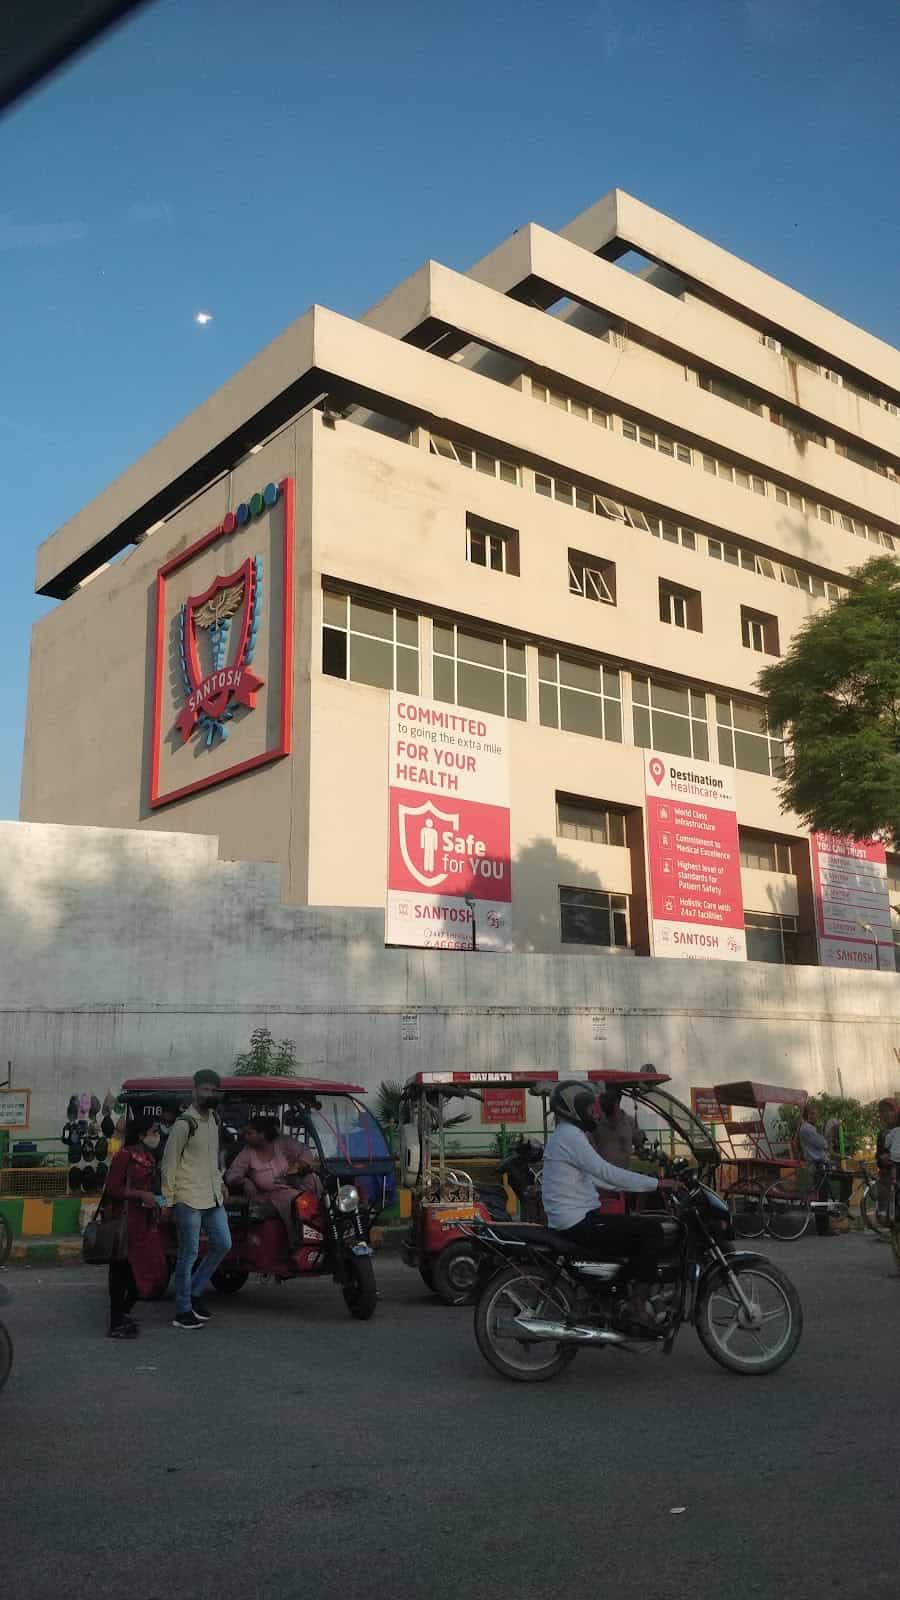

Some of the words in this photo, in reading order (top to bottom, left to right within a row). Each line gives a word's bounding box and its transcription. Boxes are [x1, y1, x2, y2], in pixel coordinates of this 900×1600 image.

[188, 670, 242, 712] SANTOSH
[396, 702, 487, 737] COMMITTED
[398, 722, 408, 734] to
[410, 727, 437, 743] going
[439, 731, 456, 745] the
[457, 737, 482, 751] extra
[483, 743, 503, 756] mile
[396, 740, 429, 763] FOR
[433, 747, 477, 773] YOUR
[396, 762, 459, 791] HEALTH
[669, 767, 724, 789] Destination
[670, 780, 719, 799] Healthcare
[673, 807, 692, 817] World
[674, 818, 716, 831] Infrastructure
[441, 830, 487, 857] Safe
[675, 833, 713, 847] Commitment
[676, 844, 700, 855] Medical
[700, 847, 731, 860] Excellence
[847, 846, 867, 859] TRUST
[441, 853, 465, 873] for
[468, 857, 504, 880] YOU
[677, 860, 702, 871] Highest
[702, 863, 717, 874] level
[678, 879, 702, 891] Patient
[702, 883, 722, 897] Safety
[414, 904, 475, 923] SANTOSH
[679, 897, 703, 908] Holistic
[703, 900, 717, 910] Care
[717, 903, 732, 912] with
[673, 931, 719, 948] SANTOSH
[836, 948, 874, 964] SANTOSH
